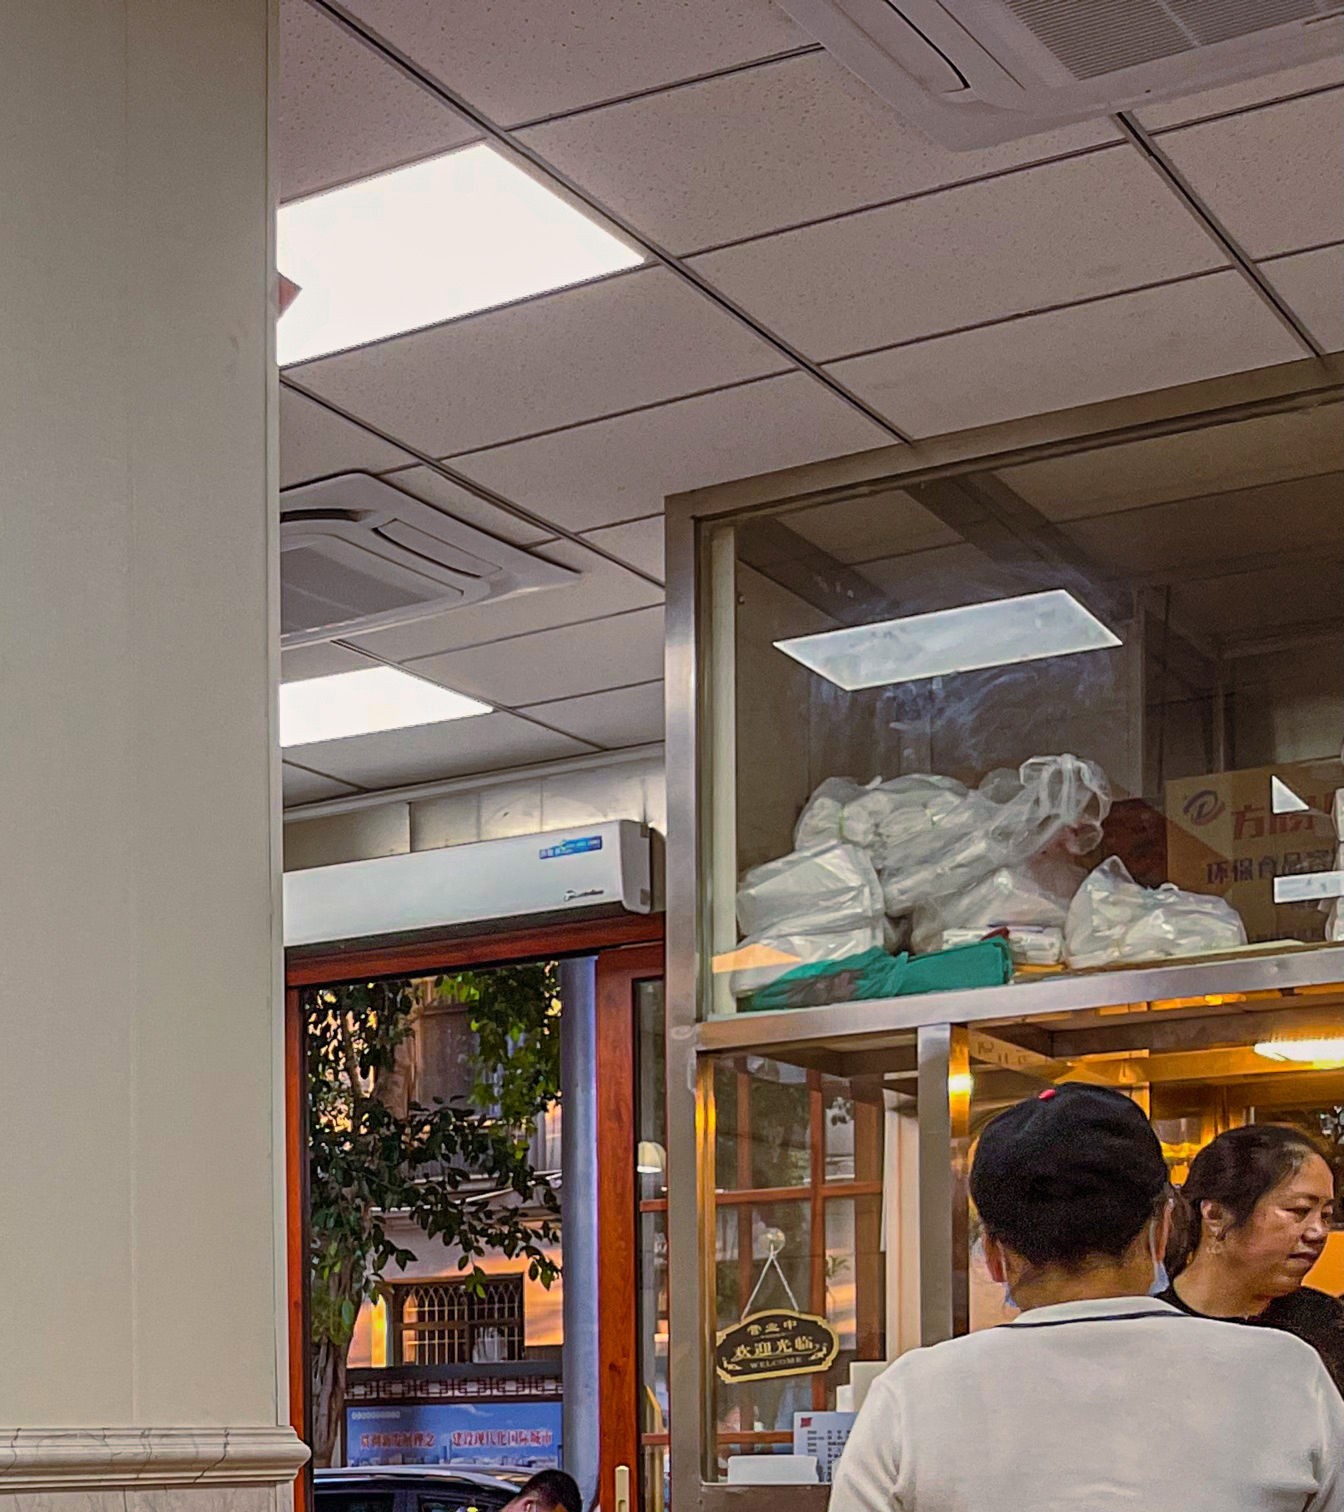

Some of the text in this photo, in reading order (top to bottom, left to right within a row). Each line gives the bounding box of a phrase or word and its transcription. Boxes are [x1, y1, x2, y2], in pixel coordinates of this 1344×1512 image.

[734, 1335, 814, 1359] 欢迎光临
[749, 1357, 803, 1369] WELCOME
